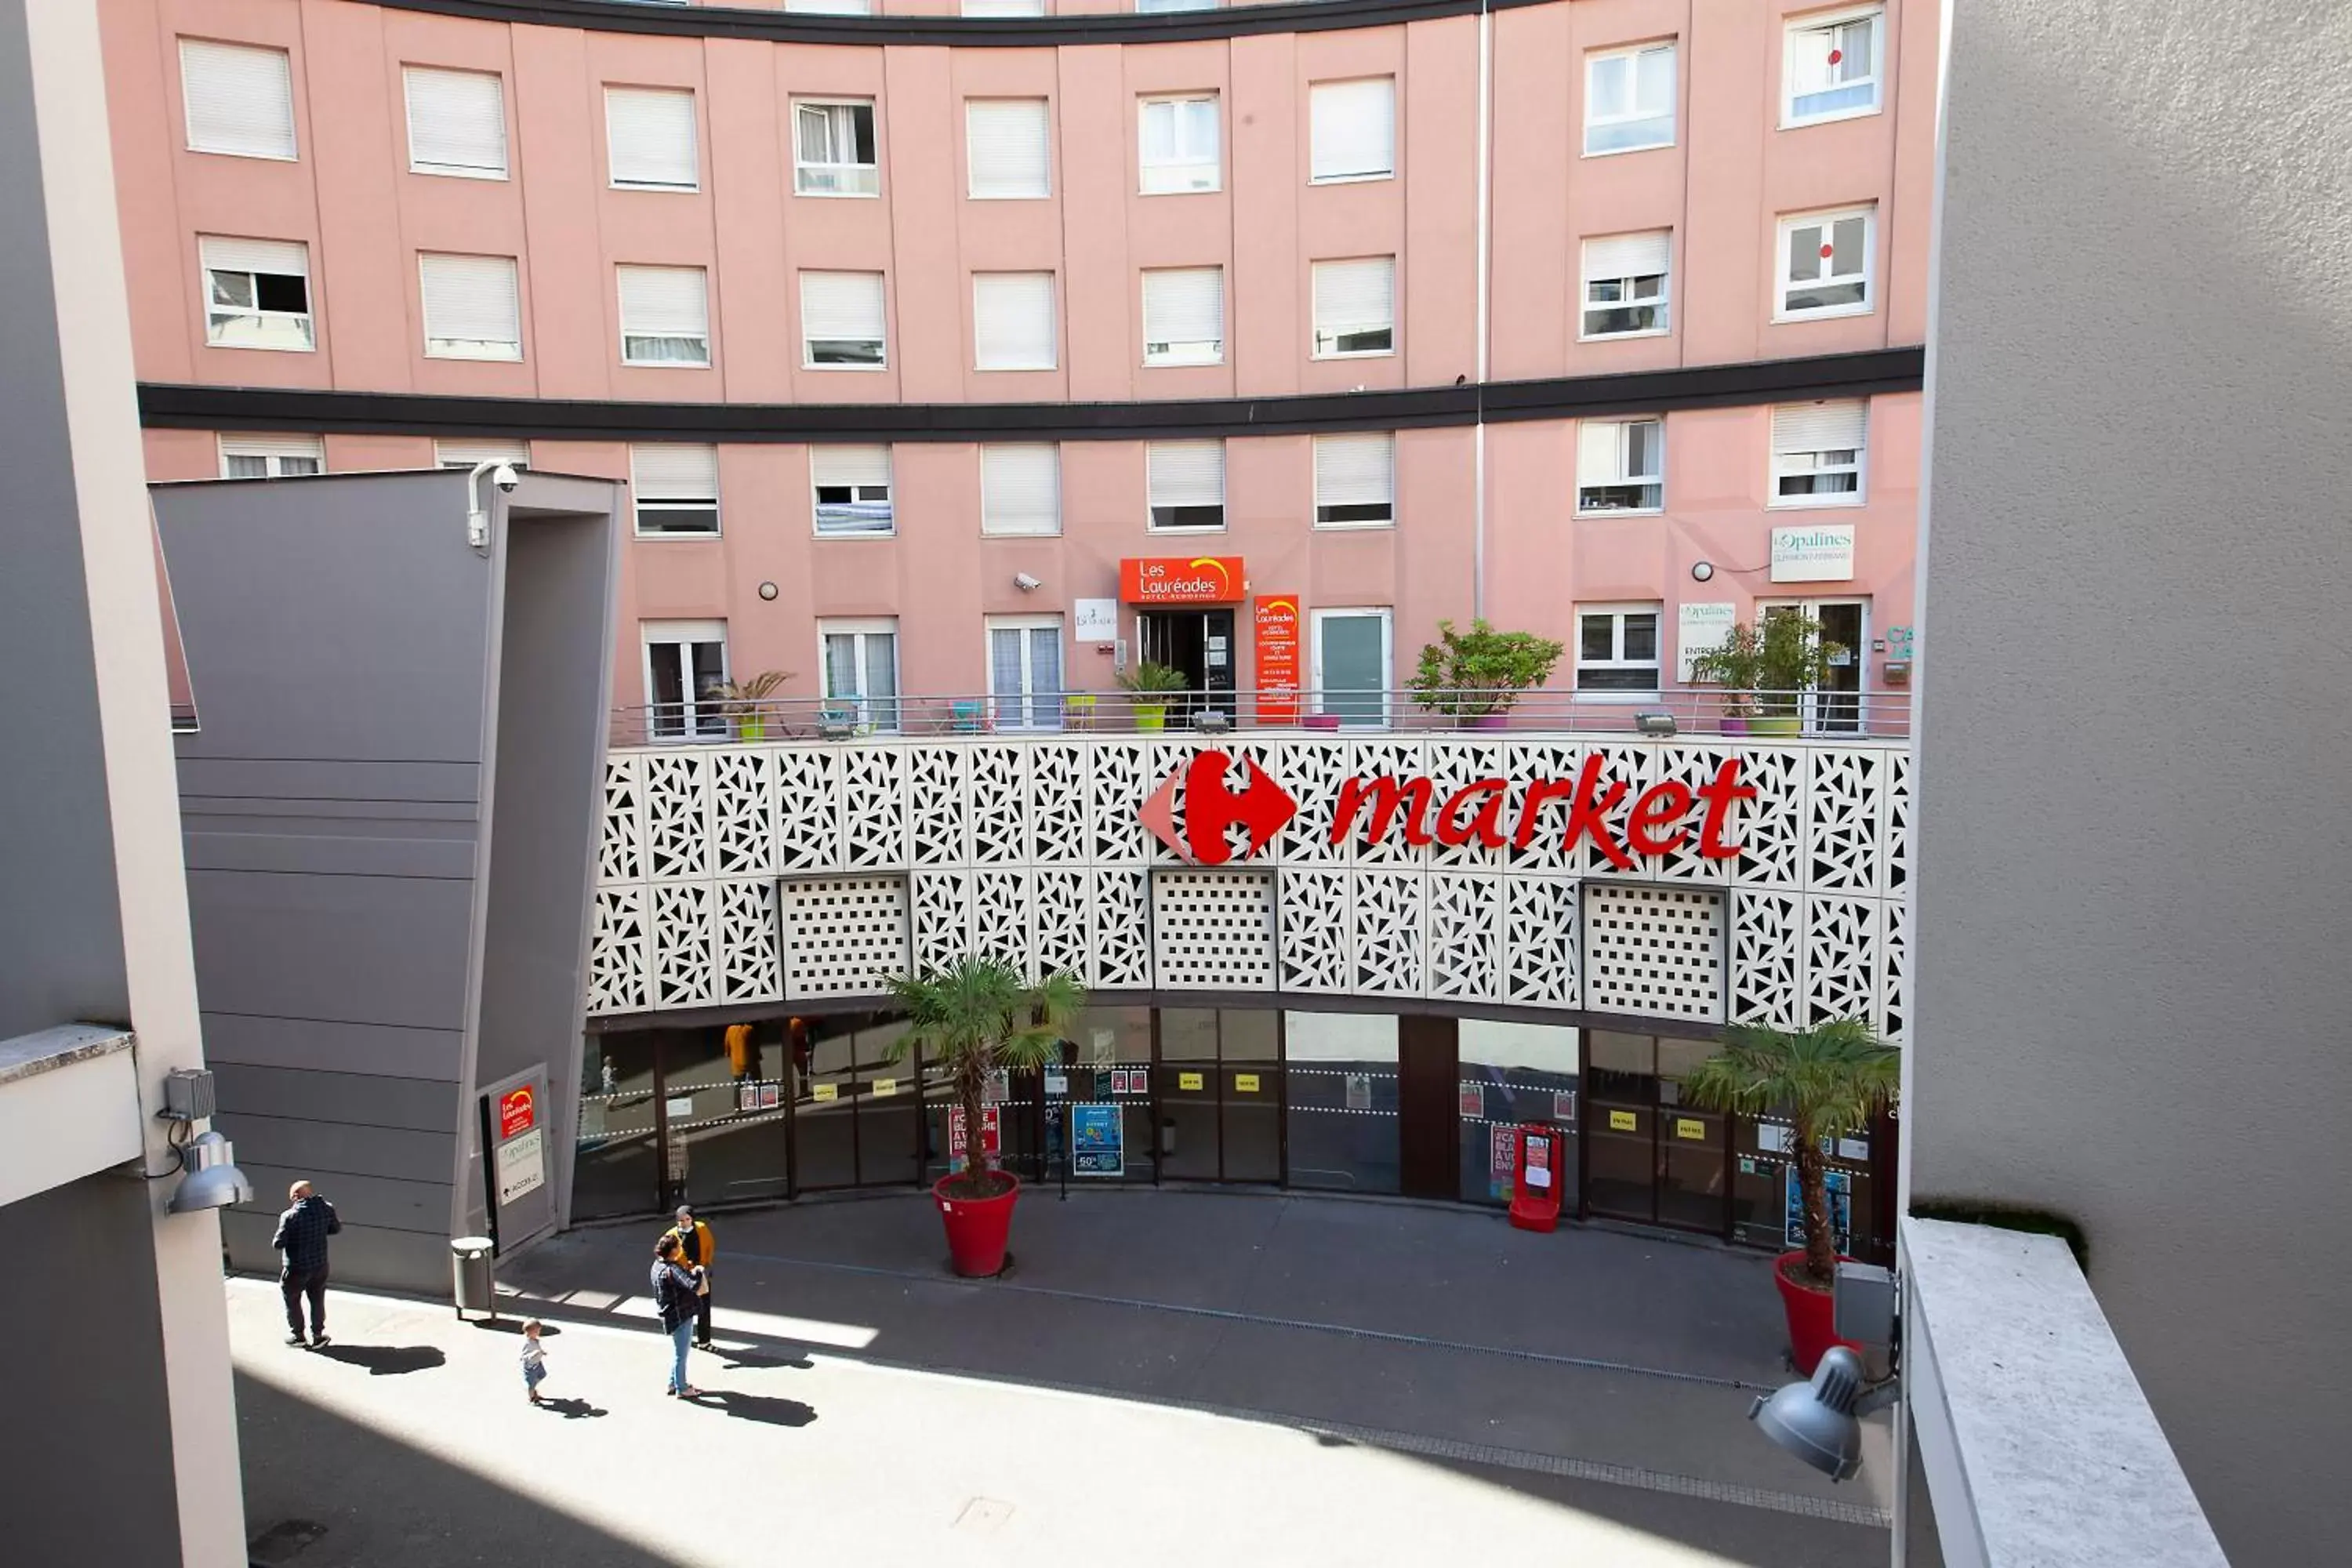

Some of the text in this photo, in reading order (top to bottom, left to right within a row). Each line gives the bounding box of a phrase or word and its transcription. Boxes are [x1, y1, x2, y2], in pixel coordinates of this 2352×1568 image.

[1140, 561, 1165, 577] Les
[1141, 577, 1217, 593] Lauréades
[1330, 753, 1759, 870] market
